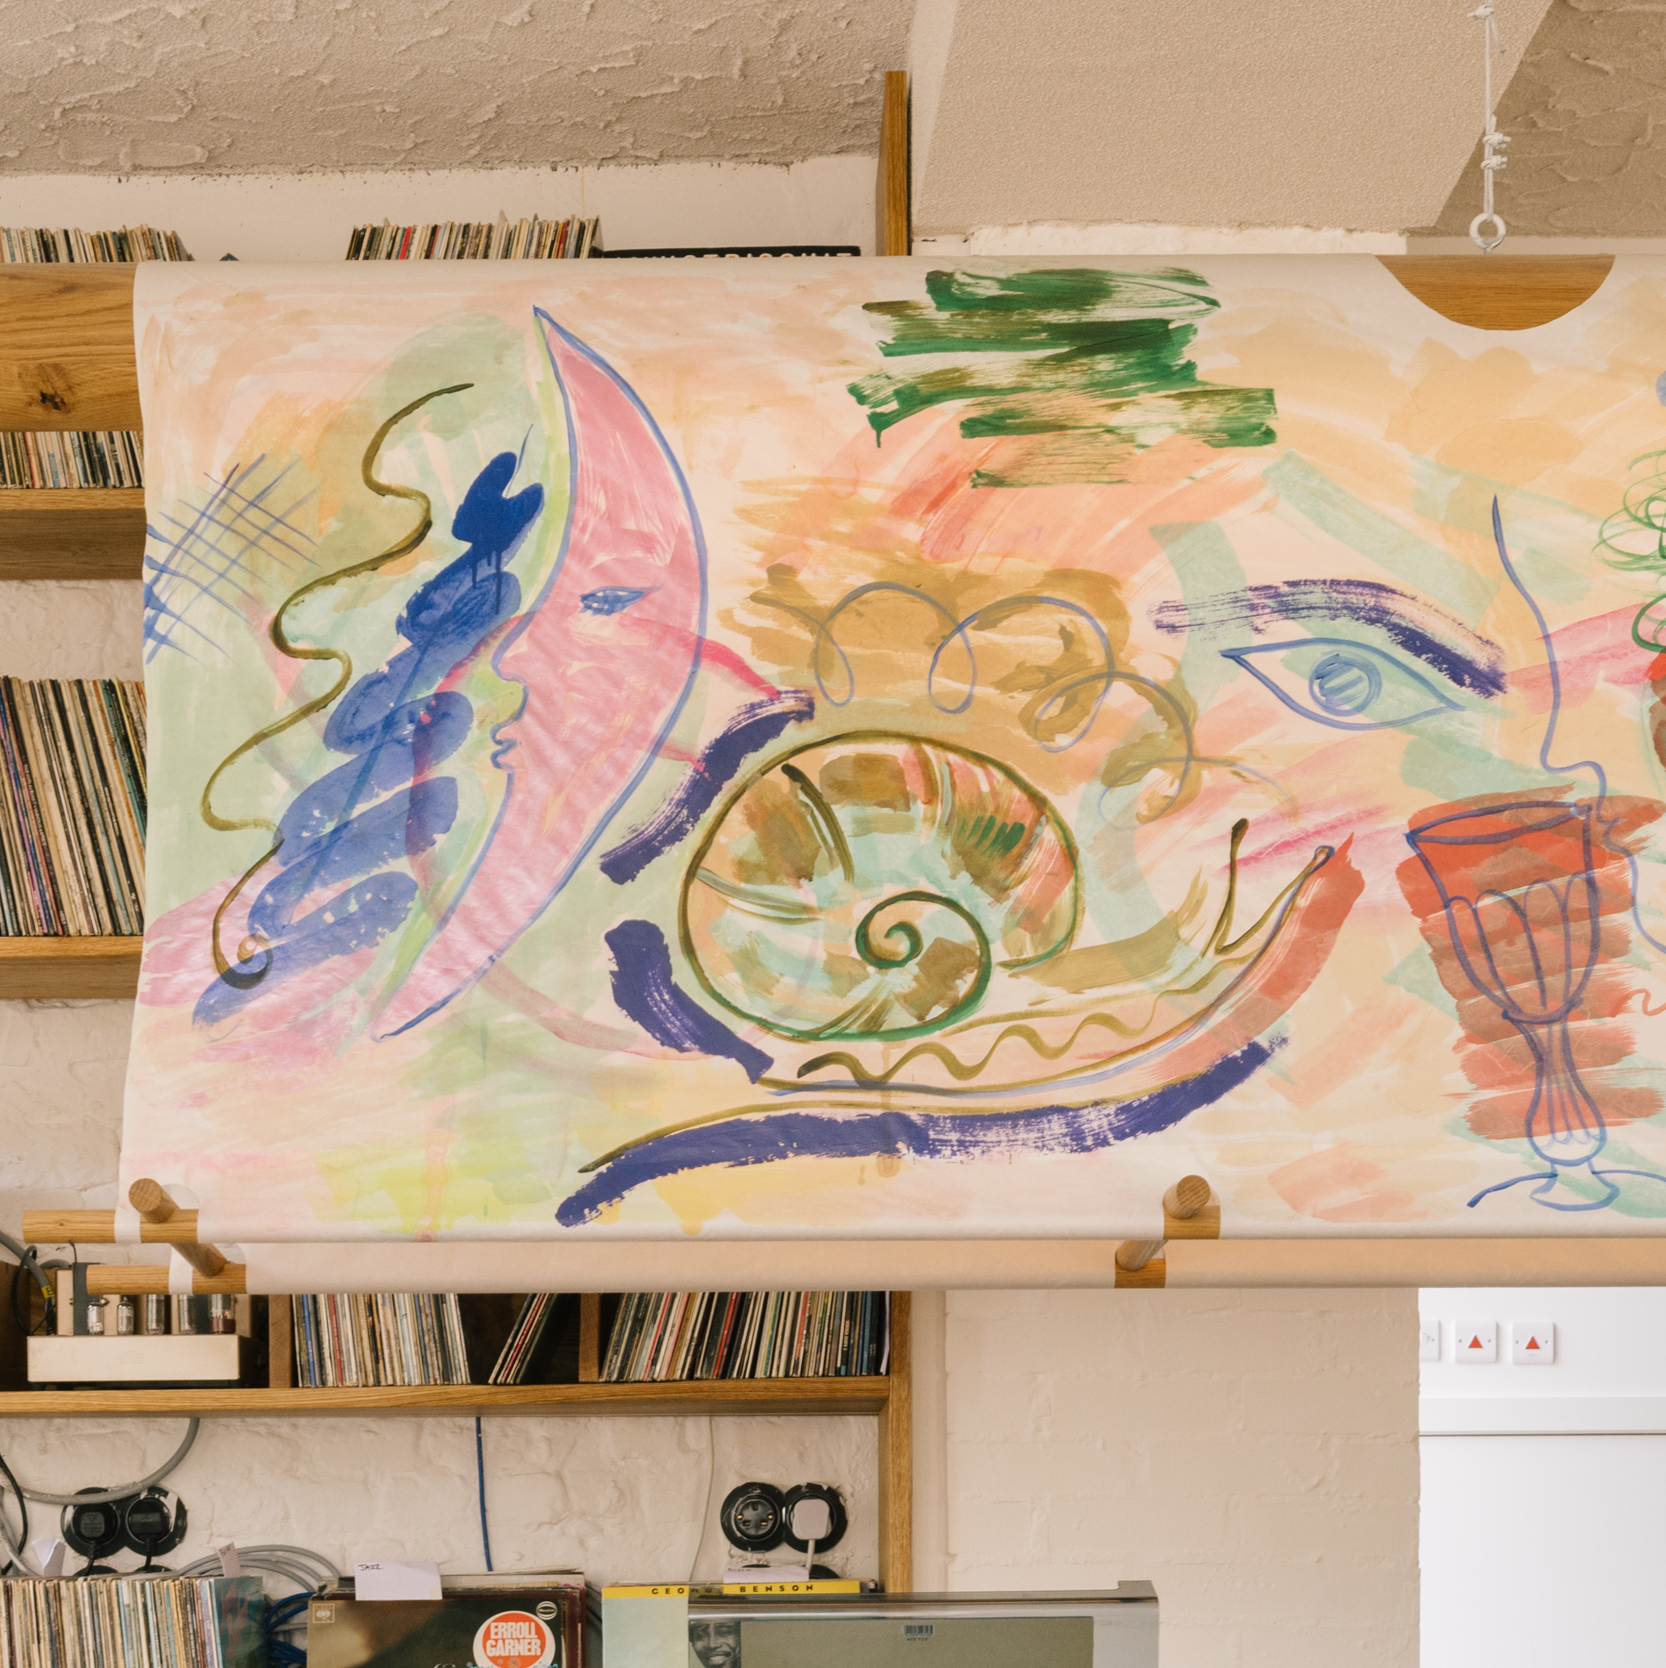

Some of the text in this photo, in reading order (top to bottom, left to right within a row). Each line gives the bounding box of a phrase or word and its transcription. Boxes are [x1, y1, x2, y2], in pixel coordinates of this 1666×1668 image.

[357, 1563, 383, 1572] JAZZ
[739, 1584, 814, 1594] BENSON
[490, 1621, 538, 1640] ERROLL
[485, 1638, 541, 1657] GARNER
